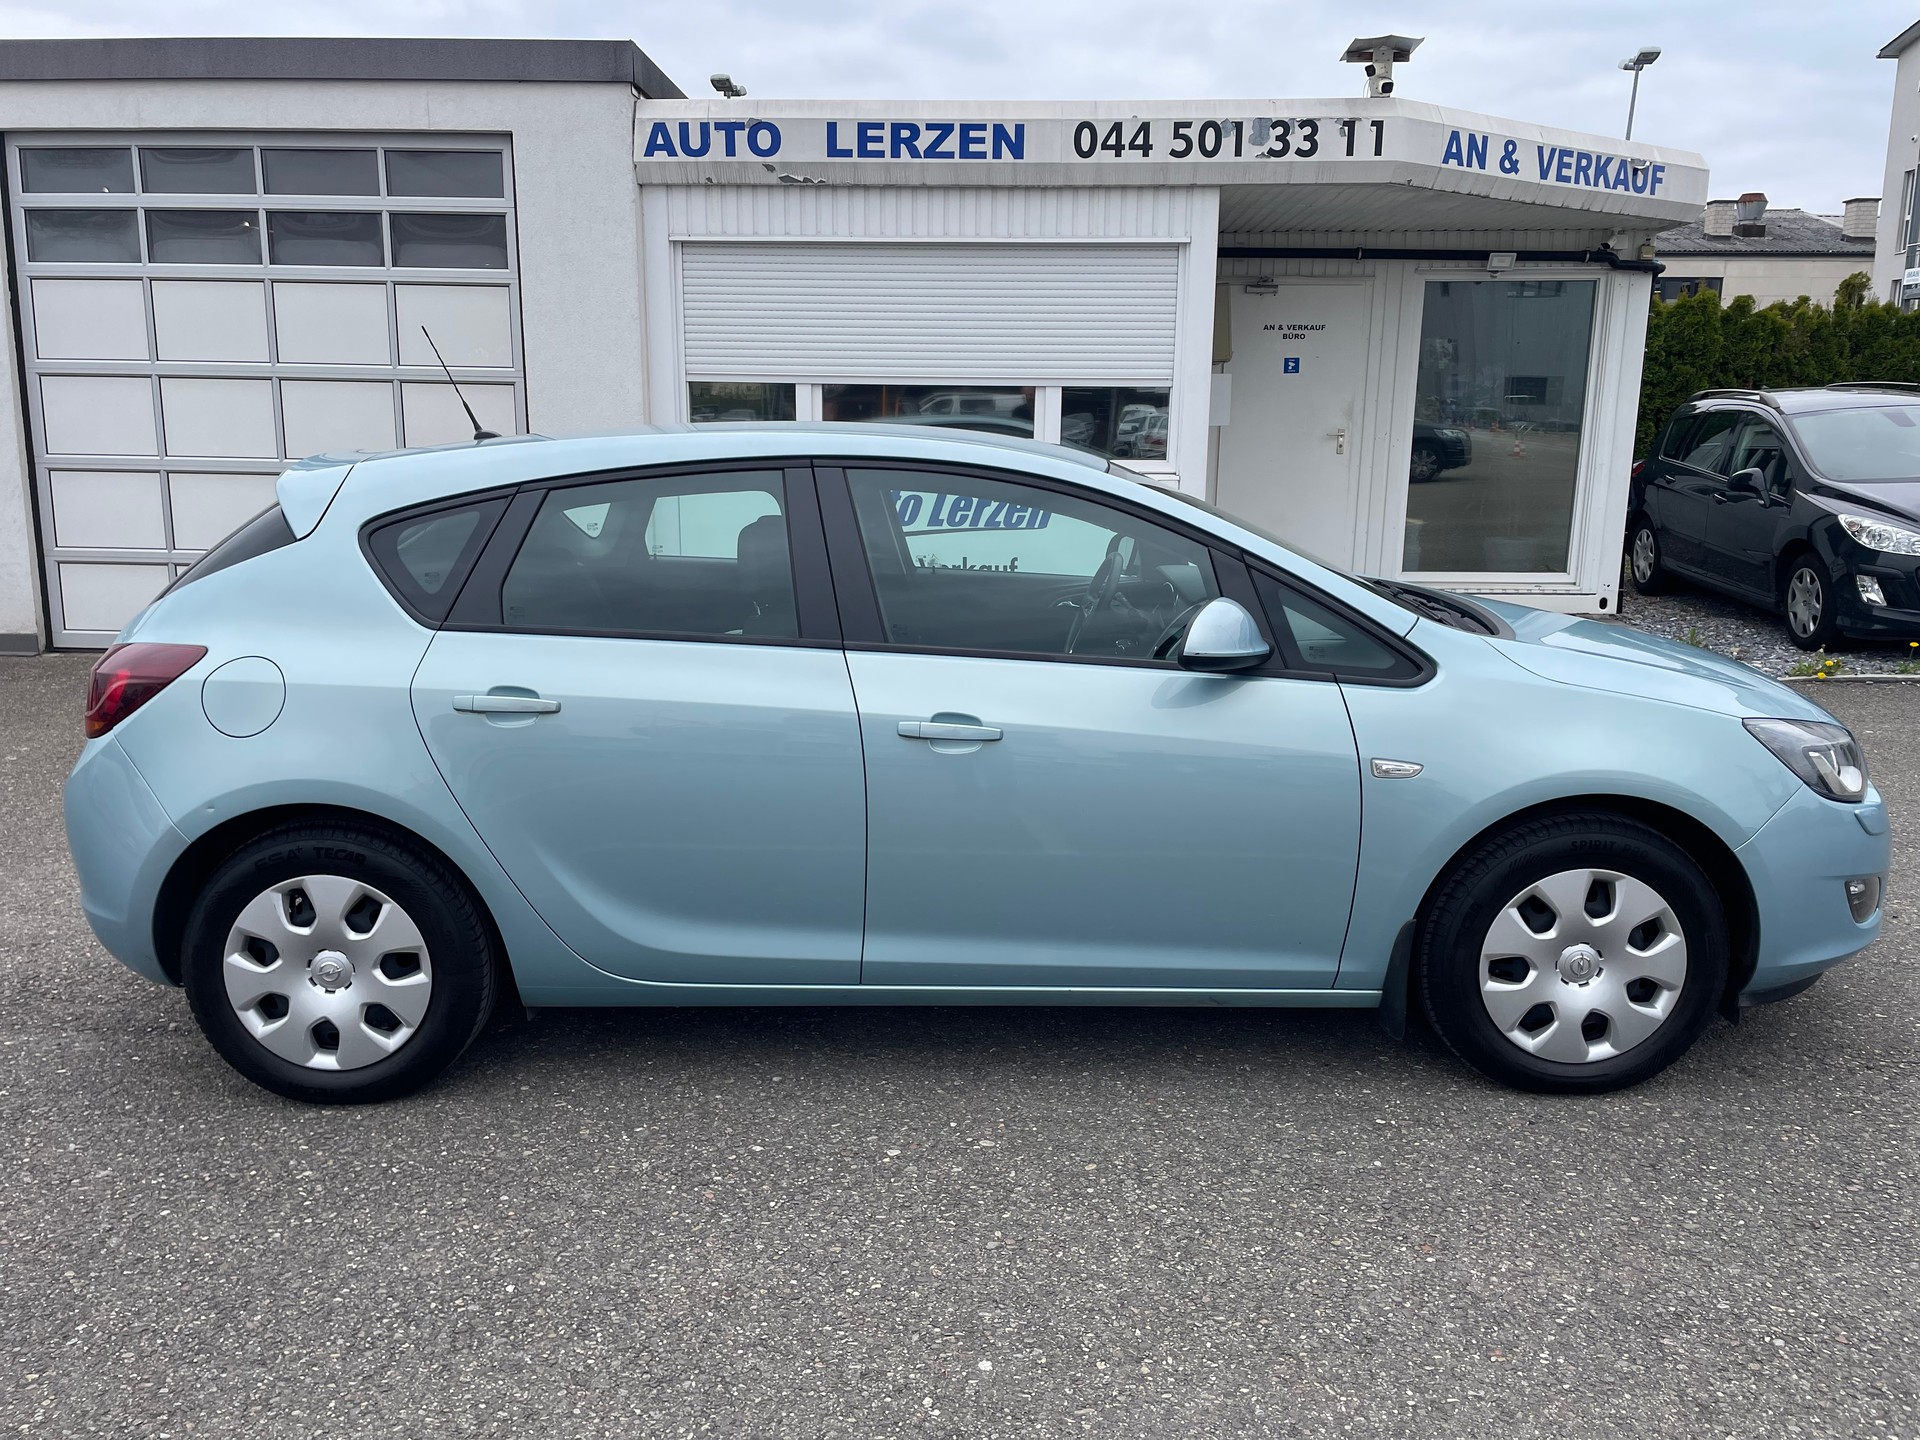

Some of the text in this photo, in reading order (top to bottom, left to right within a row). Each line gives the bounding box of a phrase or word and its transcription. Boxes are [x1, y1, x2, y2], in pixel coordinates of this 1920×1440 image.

[643, 120, 1385, 159] AUTO LERZEN 044 501 33 11
[1442, 130, 1665, 196] AN & VERKAUF
[1282, 332, 1306, 340] BÜRO
[926, 493, 1052, 528] Lerzen
[312, 846, 367, 865] TECAR
[1570, 839, 1616, 851] SPIRIT
